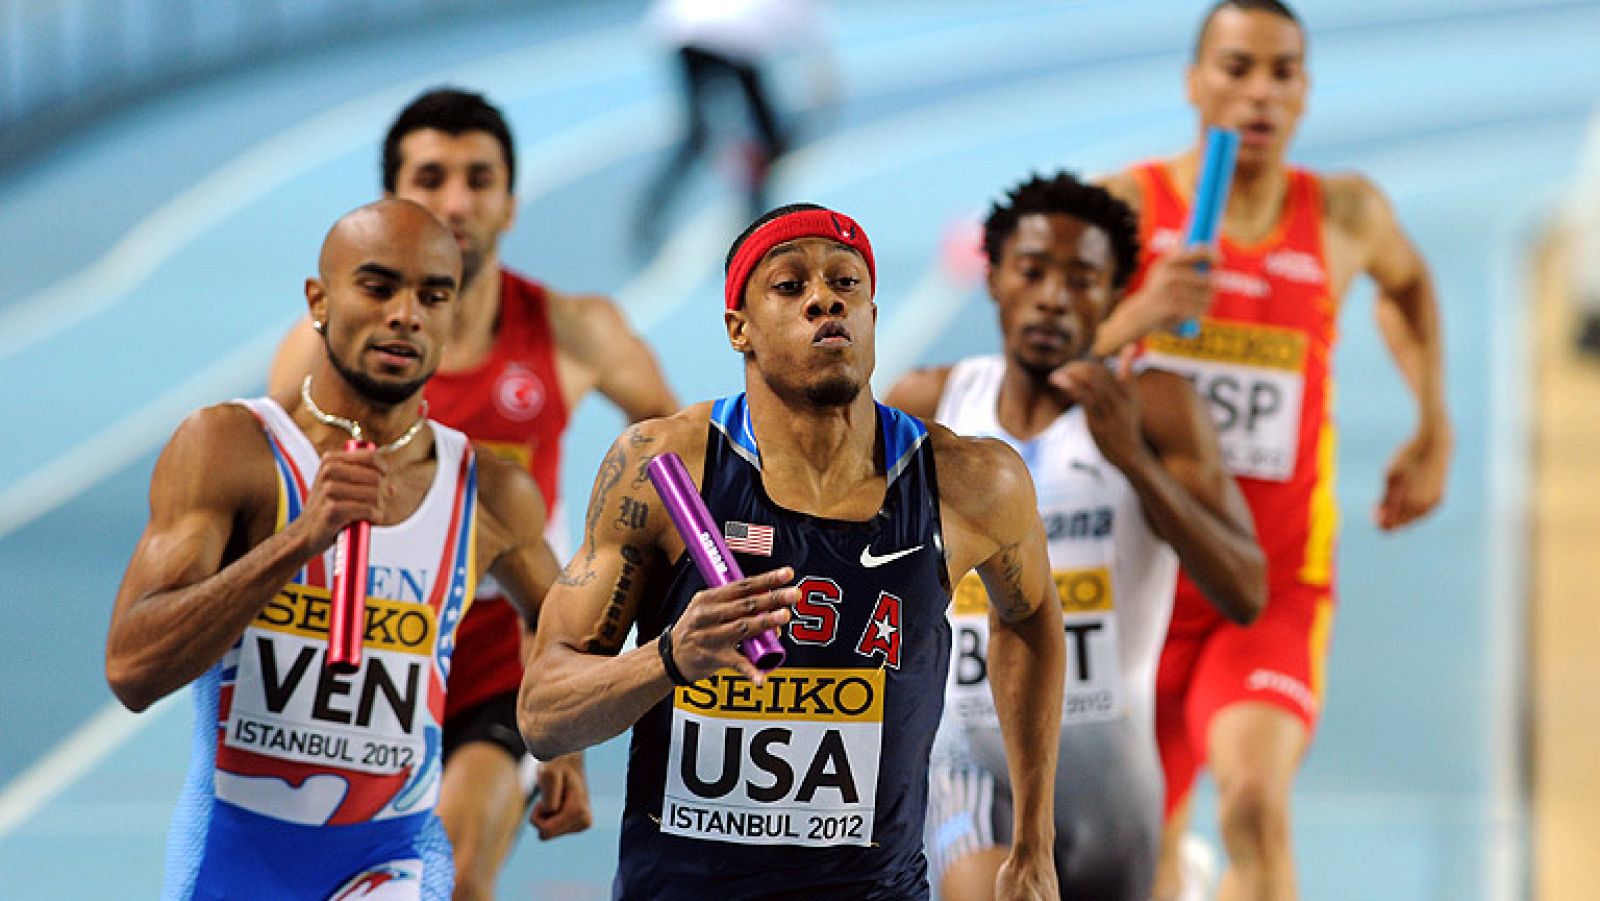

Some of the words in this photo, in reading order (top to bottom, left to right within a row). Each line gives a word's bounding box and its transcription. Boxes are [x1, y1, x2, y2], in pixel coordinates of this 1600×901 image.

[367, 565, 428, 604] EN
[257, 591, 429, 647] SEKO
[788, 575, 902, 670] SA
[956, 620, 1104, 686] BT
[256, 635, 421, 735] VEN
[682, 675, 874, 716] SEIKO
[234, 718, 354, 762] ISTANBUL
[362, 742, 415, 768] 2012
[680, 719, 860, 804] USA
[670, 803, 799, 838] ISTANBUL
[807, 814, 864, 839] 2012
